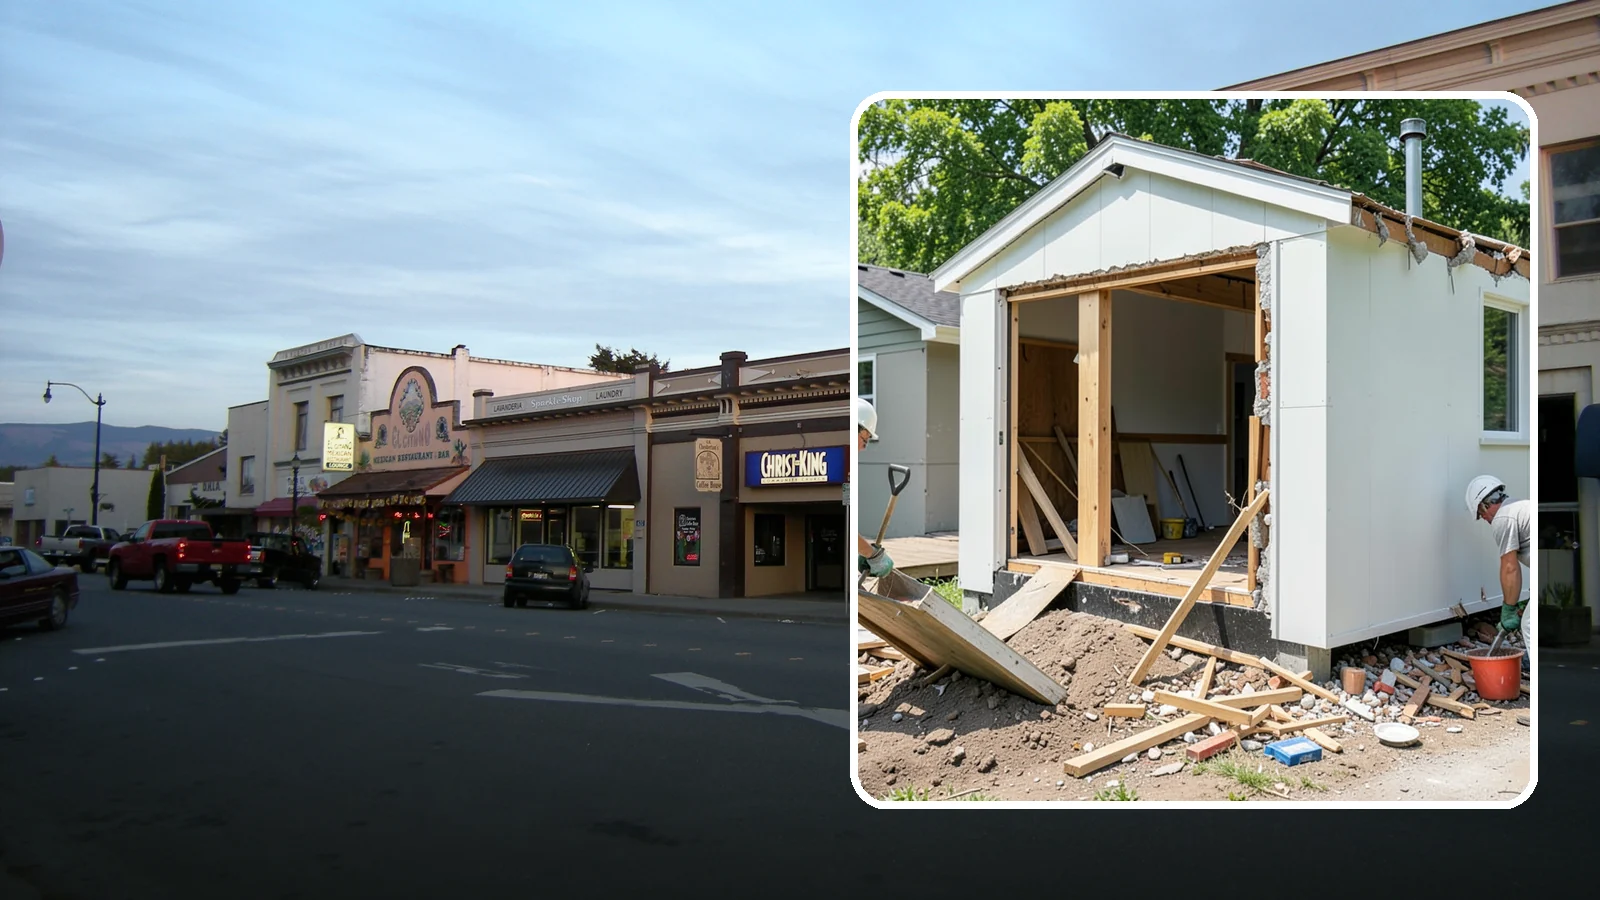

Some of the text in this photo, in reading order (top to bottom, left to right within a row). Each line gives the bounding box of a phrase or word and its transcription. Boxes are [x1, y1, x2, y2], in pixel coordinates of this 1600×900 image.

[493, 389, 623, 412] LAVANDERIA Sparkle Shop LAUNDRY
[373, 454, 397, 464] MEXICAN
[397, 451, 433, 462] RESTAURANT
[438, 450, 450, 459] BAR
[761, 450, 827, 478] CHRIST KING
